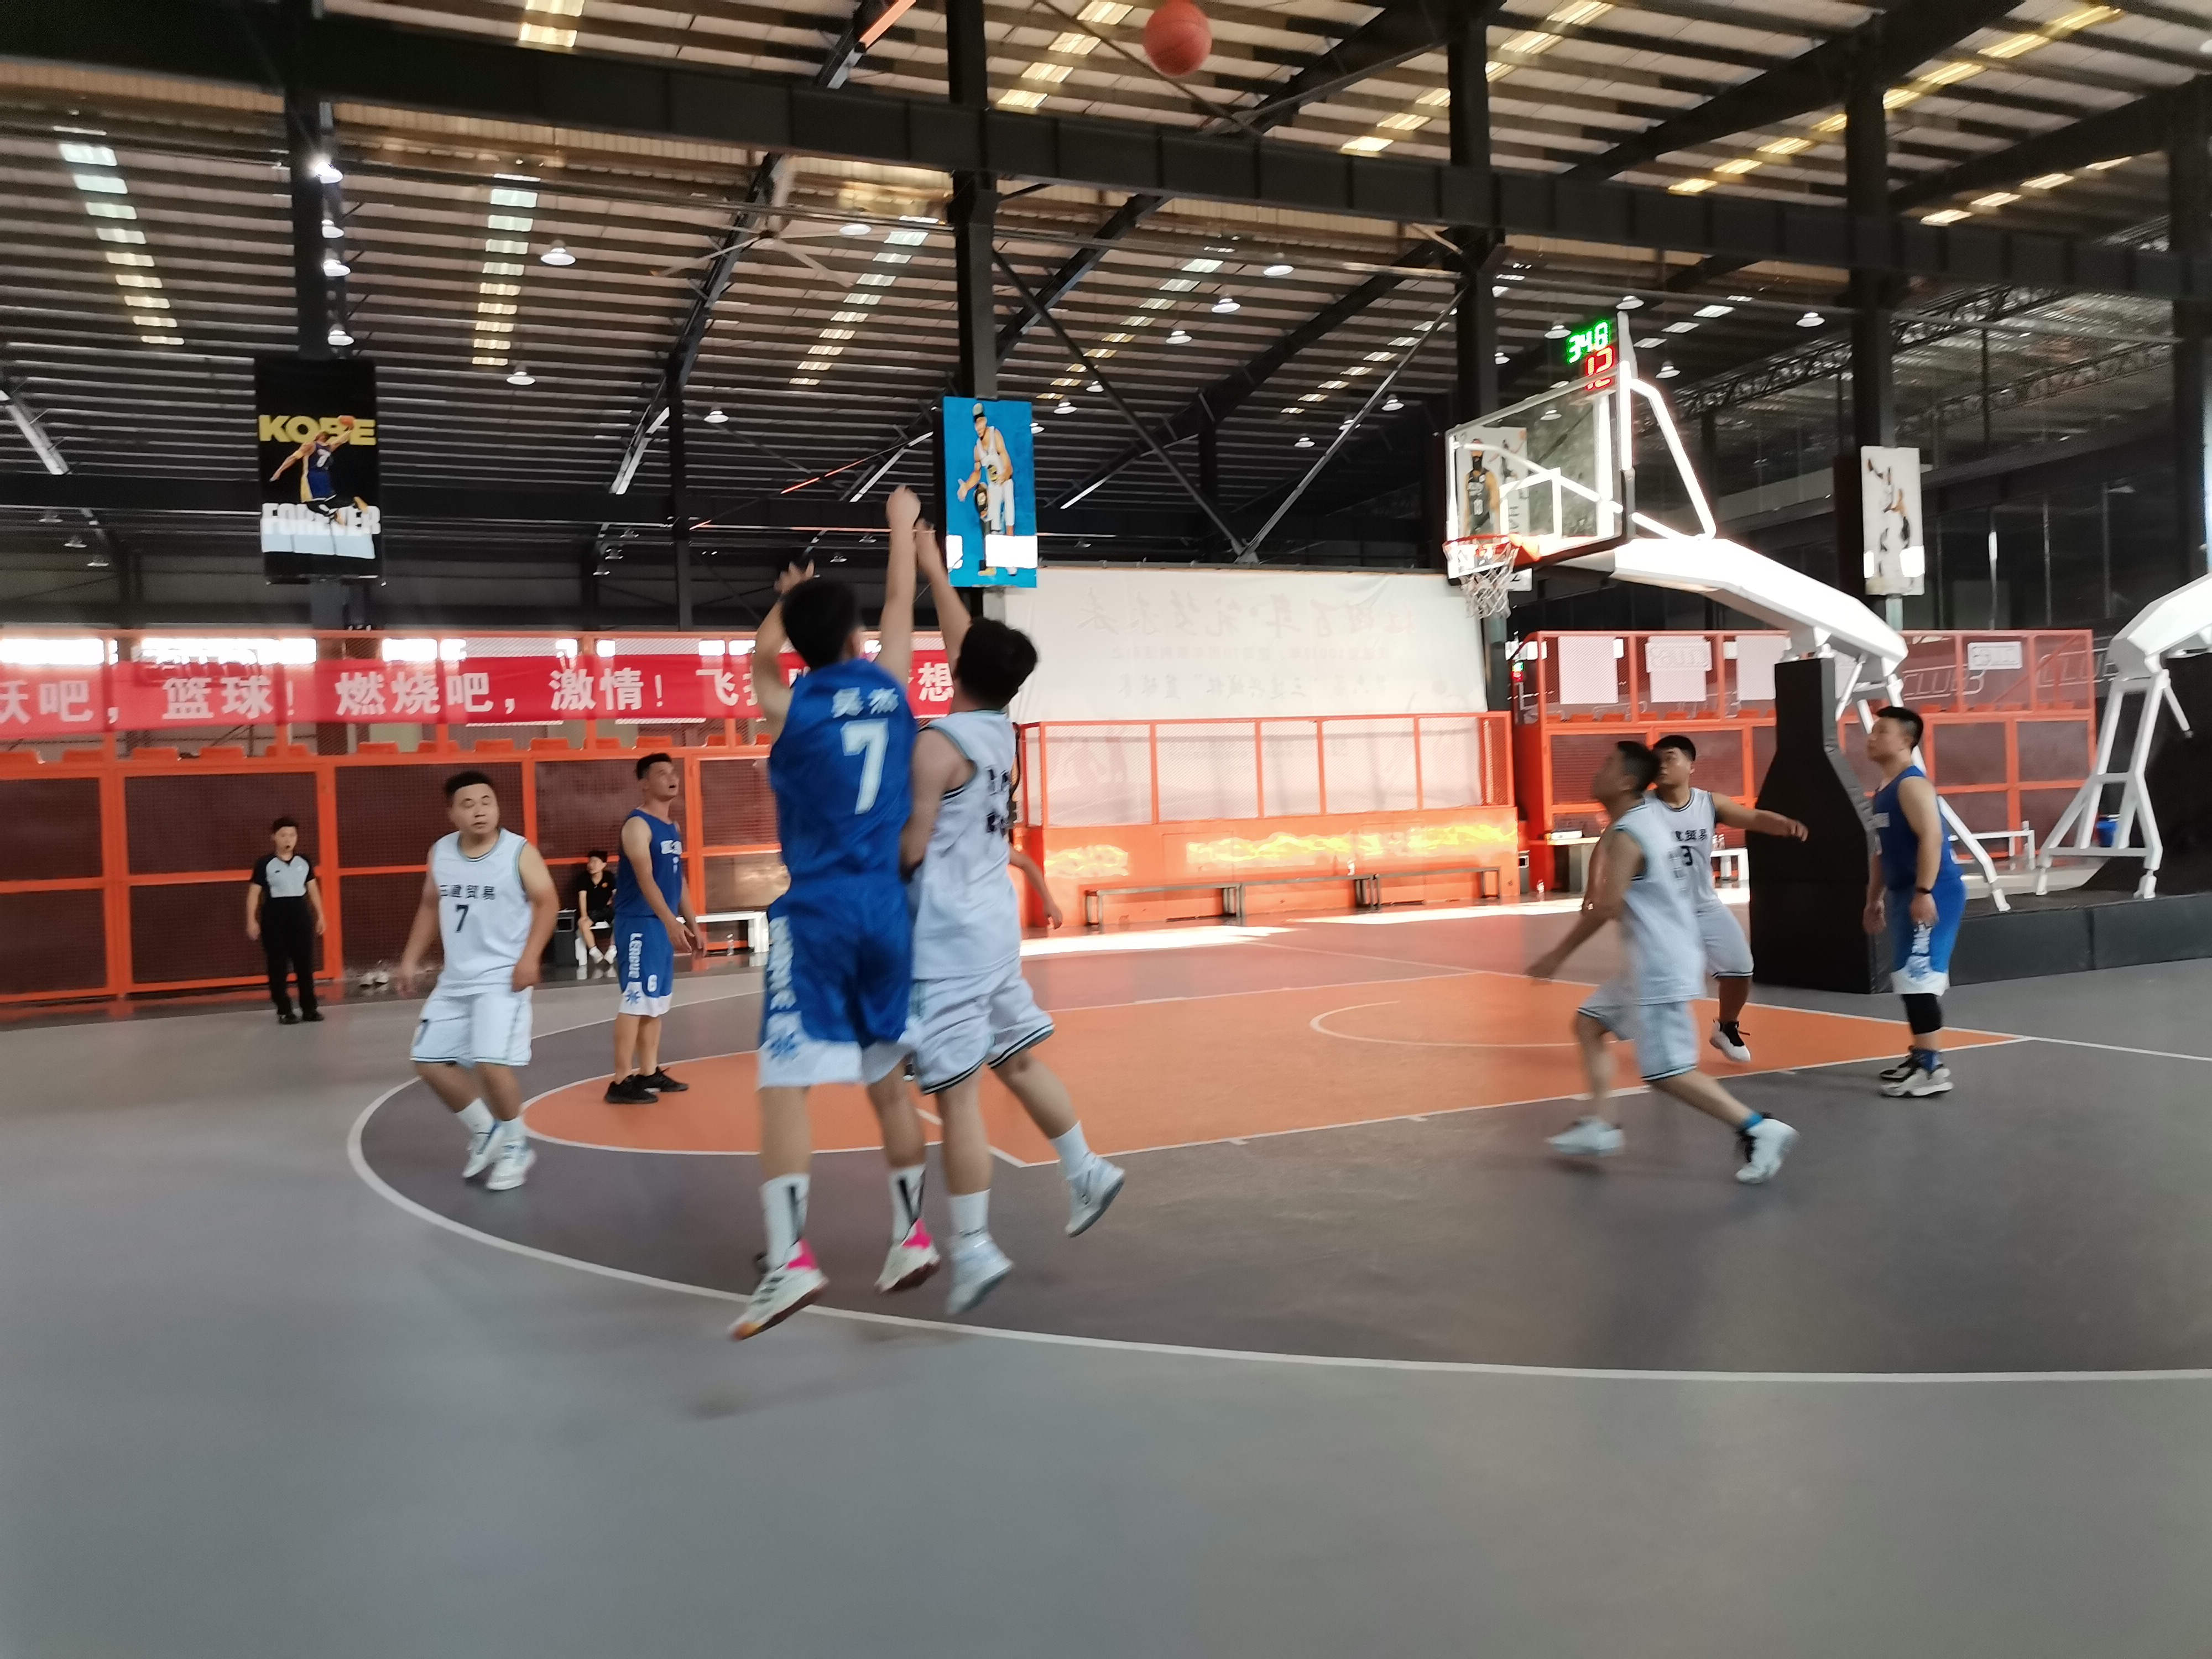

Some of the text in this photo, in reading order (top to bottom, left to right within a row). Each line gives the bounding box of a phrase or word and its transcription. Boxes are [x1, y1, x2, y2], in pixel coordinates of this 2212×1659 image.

[258, 415, 377, 446] KOBE
[841, 718, 889, 815] 7
[455, 904, 469, 933] 7
